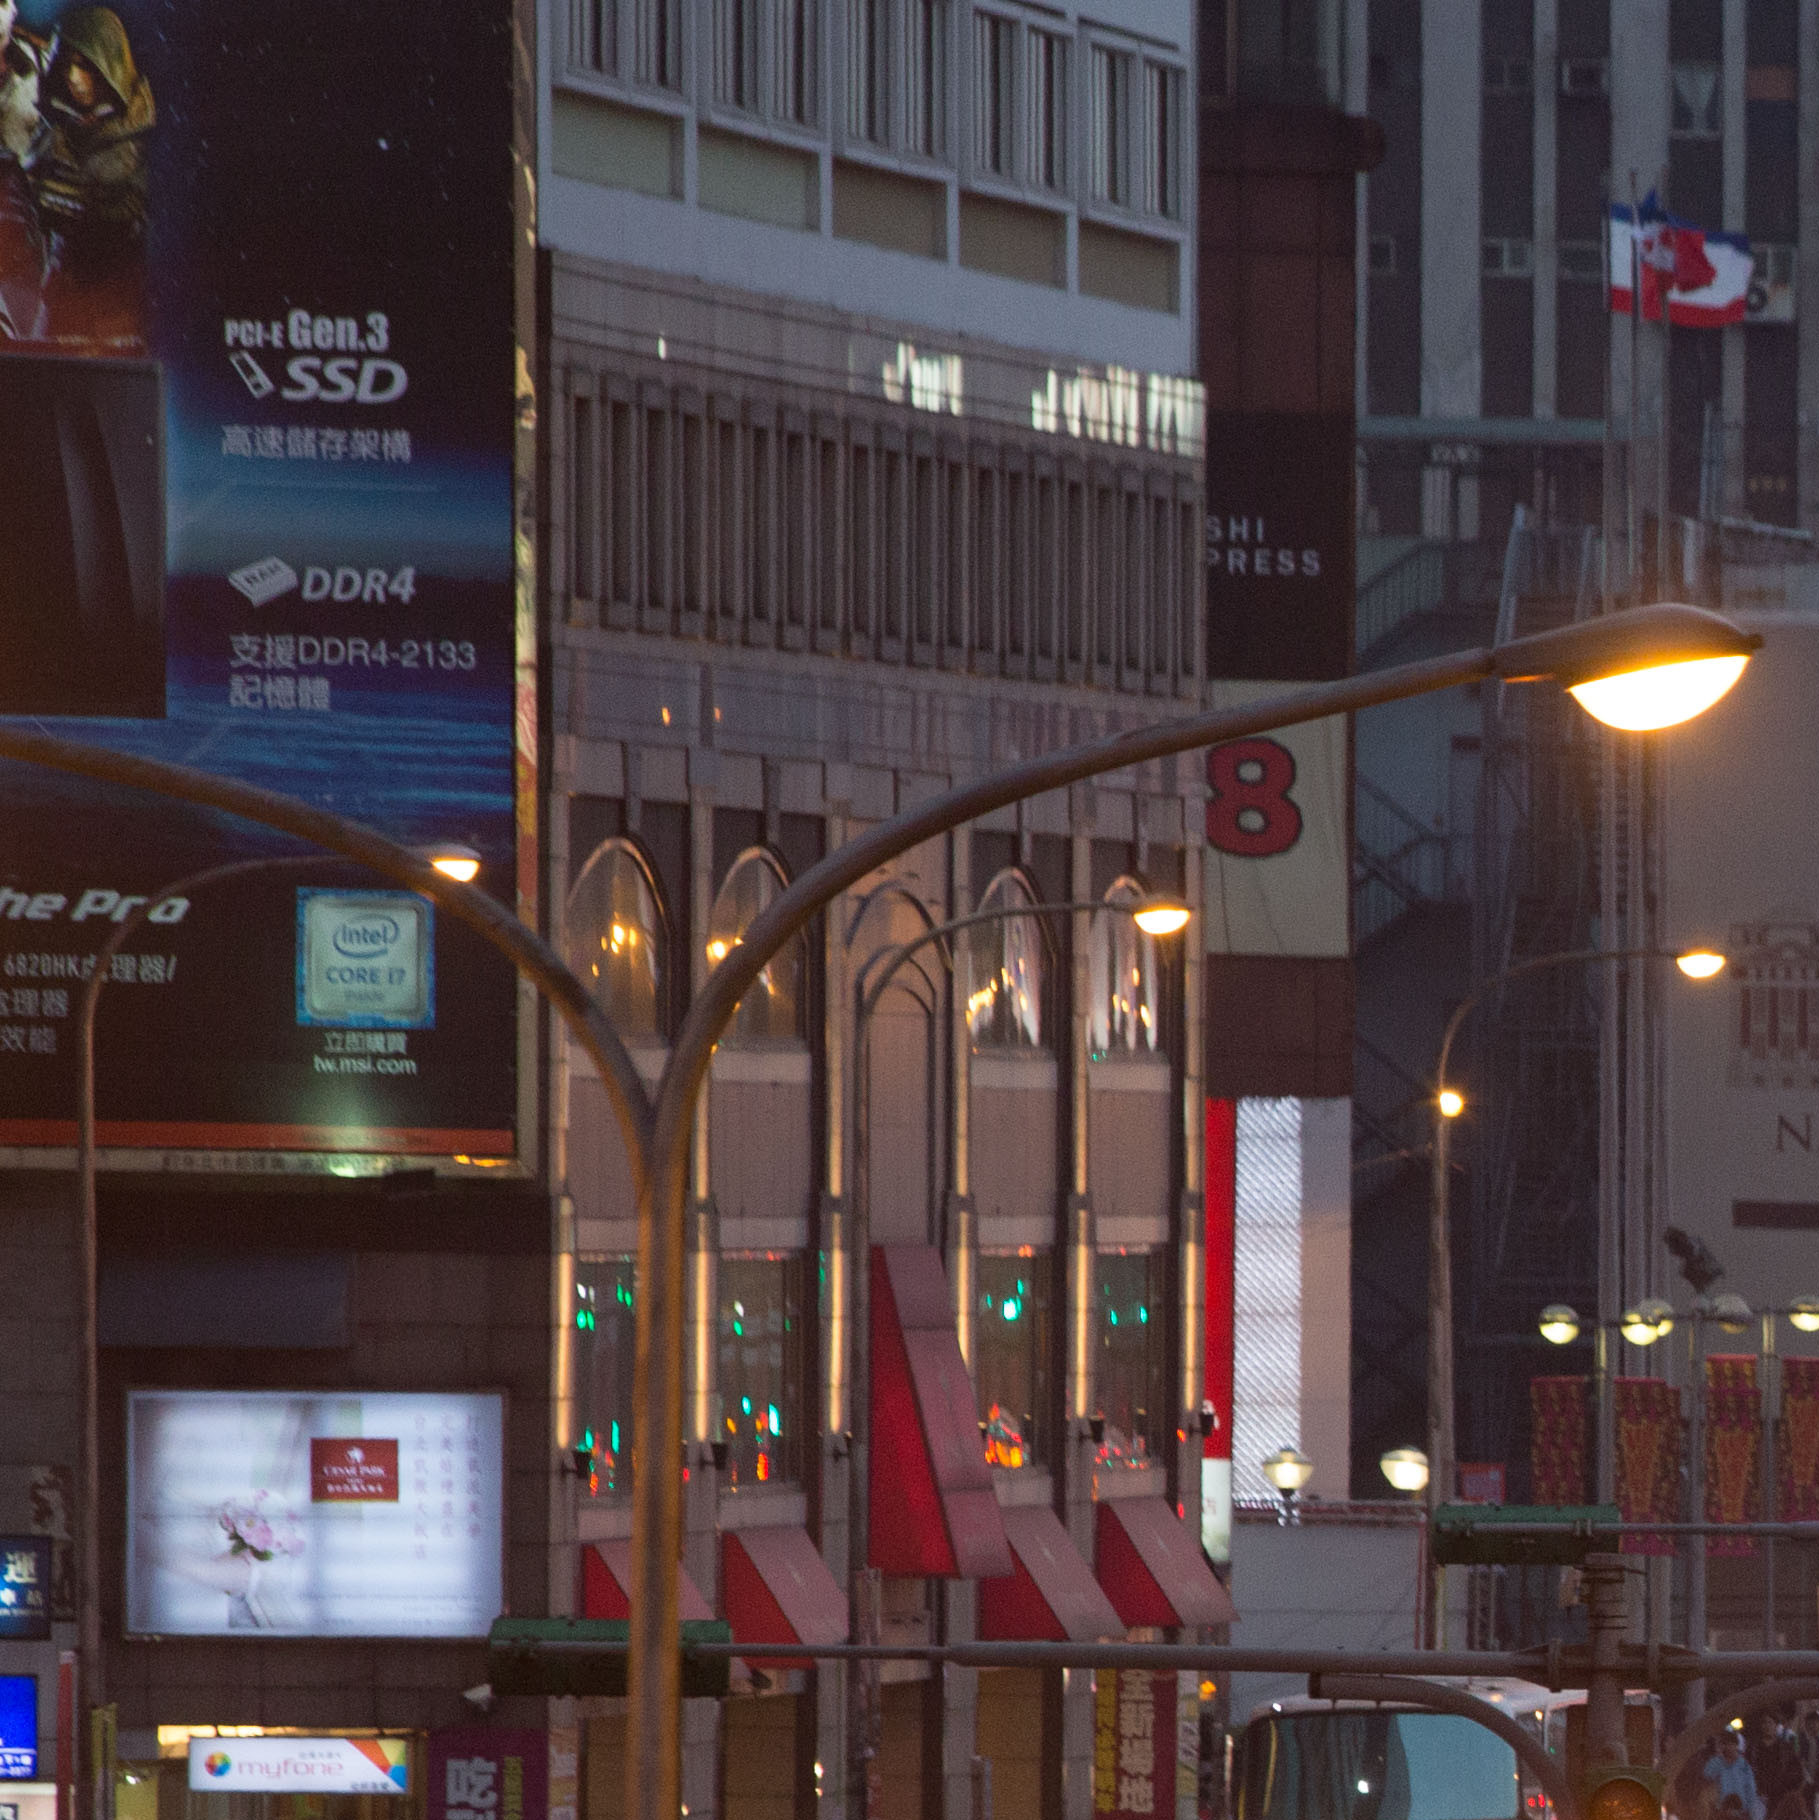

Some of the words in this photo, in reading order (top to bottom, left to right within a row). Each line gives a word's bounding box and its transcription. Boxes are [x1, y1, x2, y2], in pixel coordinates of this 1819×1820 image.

[287, 308, 389, 351] Gen.3
[281, 355, 408, 403] SSD
[302, 566, 416, 604] DDR4
[230, 633, 477, 670] 支援DDR4-2133
[1205, 736, 1302, 859] 8
[71, 889, 190, 923] Pro
[238, 1758, 344, 1779] myfone
